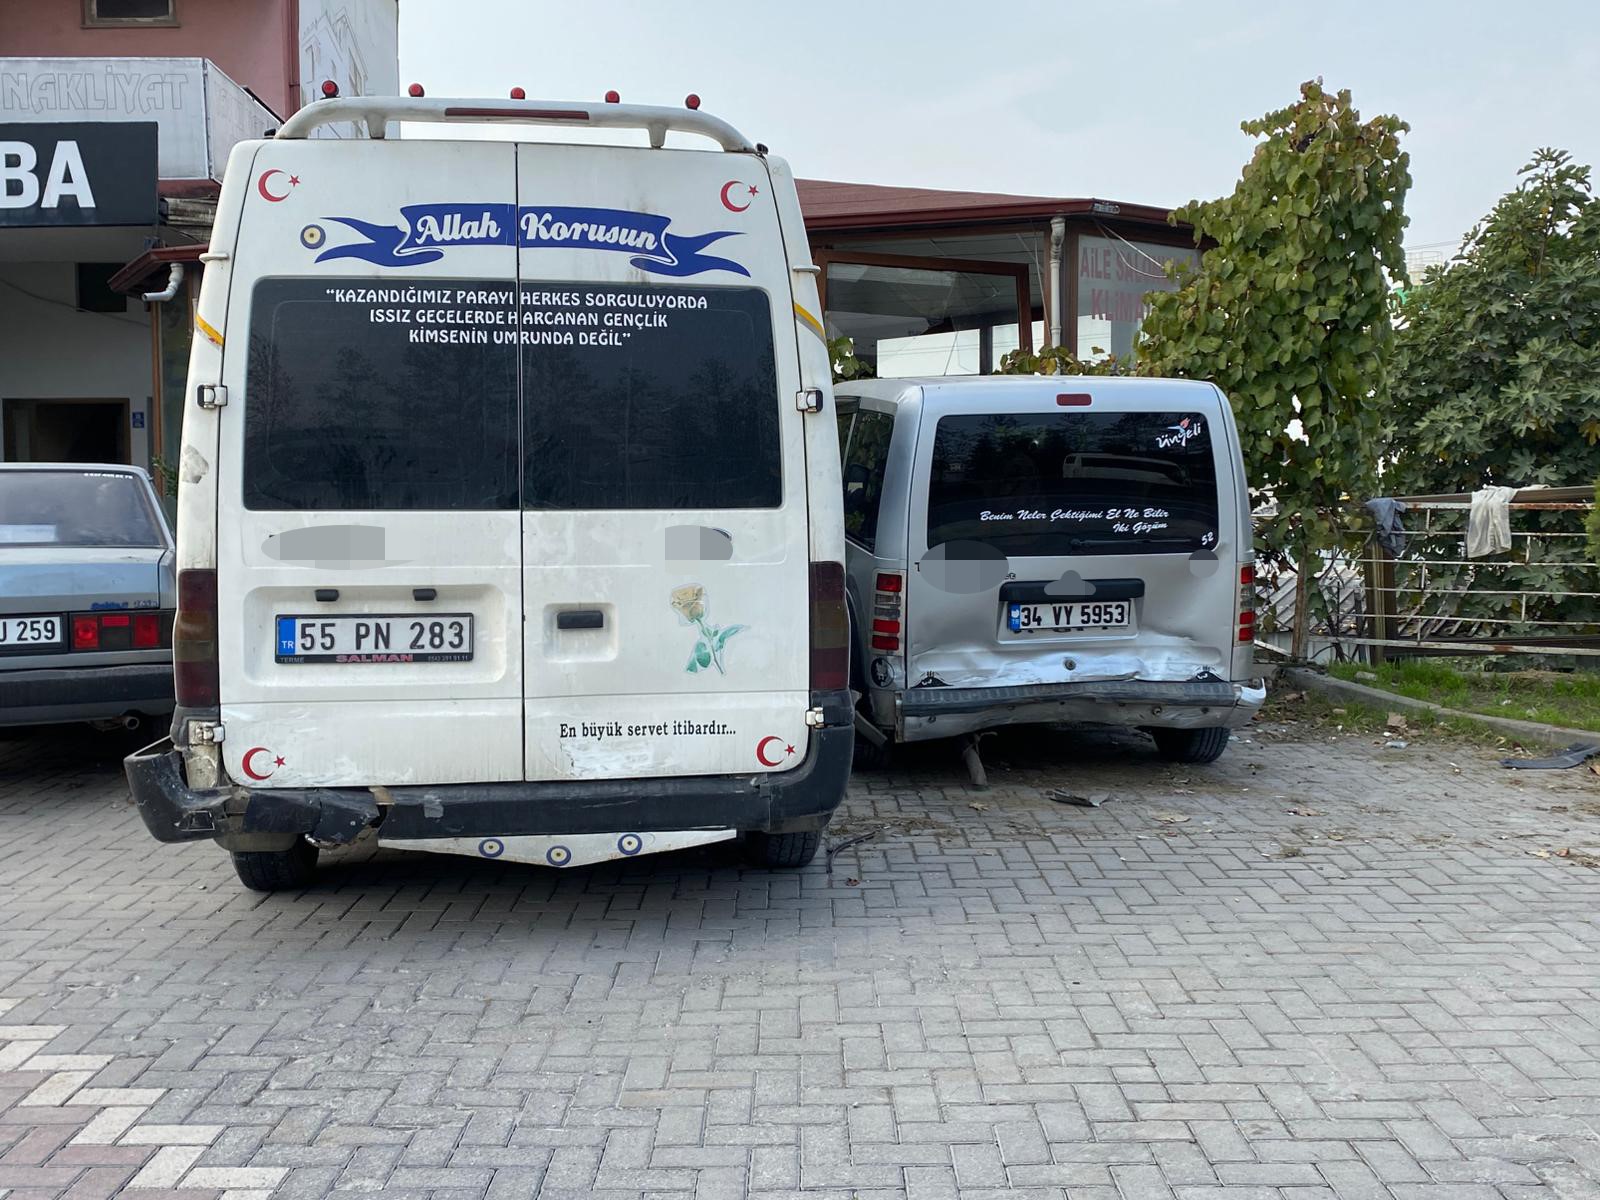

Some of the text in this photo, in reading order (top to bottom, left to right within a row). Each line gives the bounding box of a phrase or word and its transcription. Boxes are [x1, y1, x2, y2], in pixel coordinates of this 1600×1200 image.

[415, 211, 658, 249] Allah Korusun
[456, 290, 514, 305] PARAYI
[520, 291, 581, 306] HERKES
[585, 292, 708, 309] SORGULUYORDA
[370, 309, 411, 323] ISSIZ
[415, 309, 505, 325] GECELERDE
[603, 310, 668, 330] GENÇLİK
[409, 326, 488, 344] KİMSENİN
[493, 330, 574, 345] UMRUNDA
[980, 507, 1170, 522] Benim Neler Çektiğimi El Ne Bilir
[1133, 521, 1168, 534] Gözüm
[1202, 531, 1214, 546] 52
[1021, 603, 1126, 627] 34 VY 5953
[16, 619, 56, 642] 259
[300, 621, 464, 651] 55 PN 283
[281, 640, 295, 650] TR
[336, 653, 414, 663] SALMAN
[560, 723, 577, 738] En
[582, 721, 623, 741] büyük
[627, 720, 668, 736] servet
